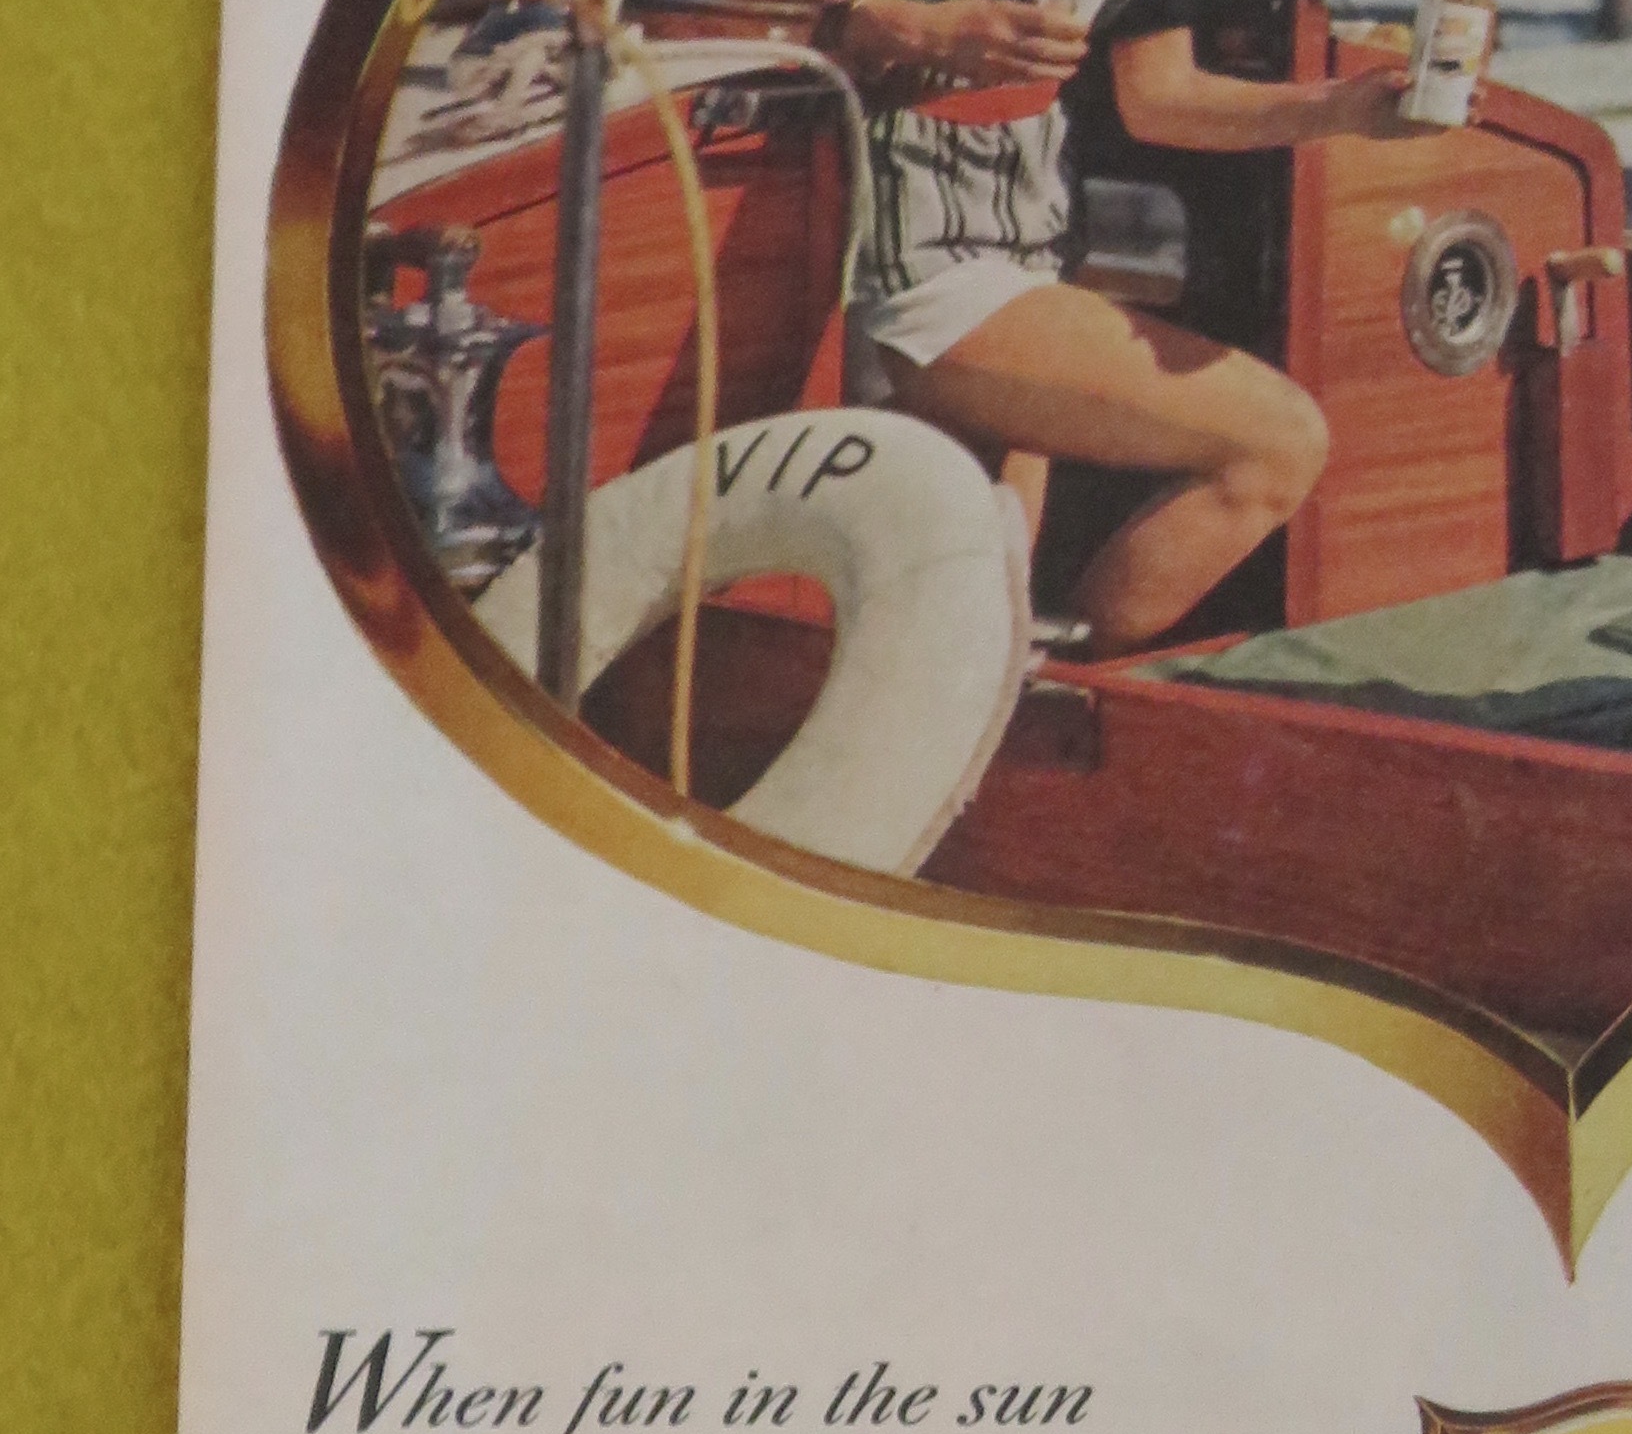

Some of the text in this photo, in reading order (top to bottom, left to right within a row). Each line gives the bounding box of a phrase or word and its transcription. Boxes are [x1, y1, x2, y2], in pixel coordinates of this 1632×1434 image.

[716, 425, 875, 500] VIP
[305, 1329, 544, 1434] When
[722, 1370, 799, 1427] in
[823, 1361, 939, 1426] the
[956, 1384, 1094, 1426] sun
